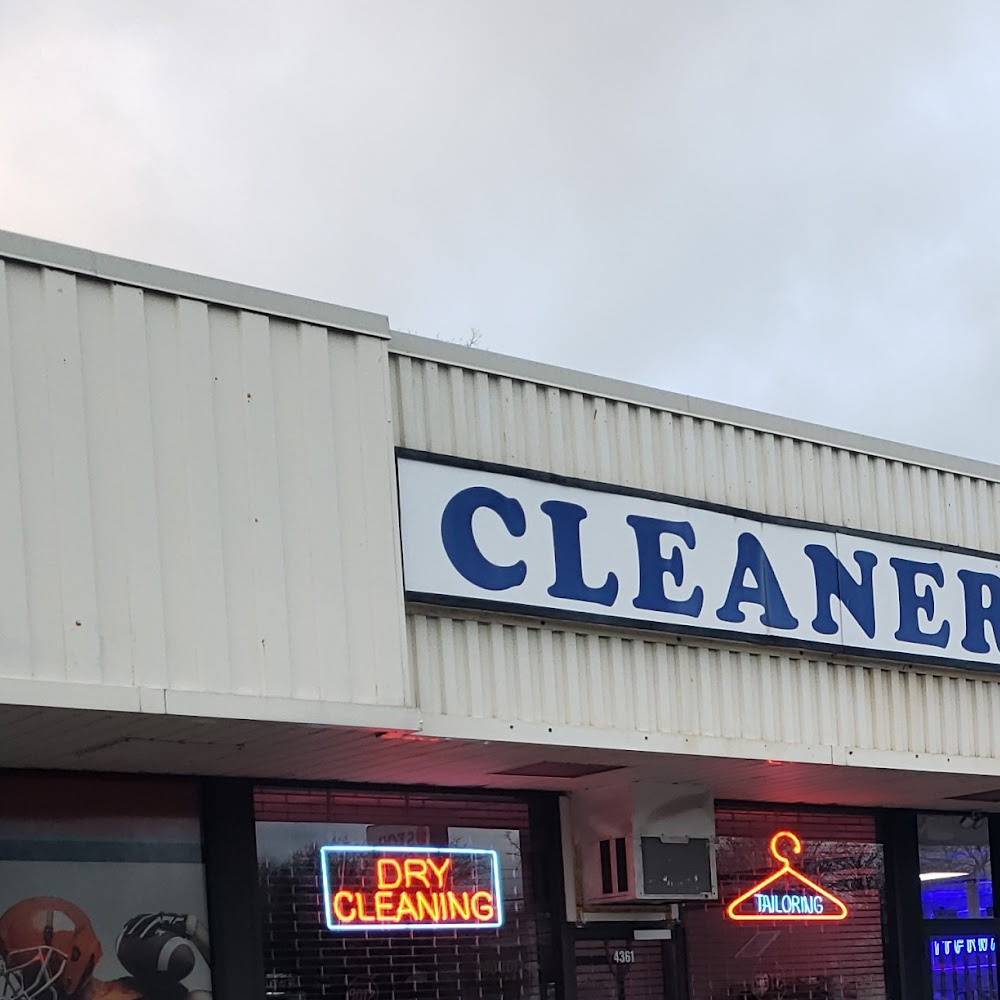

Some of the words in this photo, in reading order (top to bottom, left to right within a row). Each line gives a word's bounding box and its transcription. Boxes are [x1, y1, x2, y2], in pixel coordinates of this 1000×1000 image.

[376, 858, 451, 889] DRY
[332, 890, 494, 923] CLEANING
[754, 893, 824, 914] TAILORING
[614, 951, 635, 963] 4361
